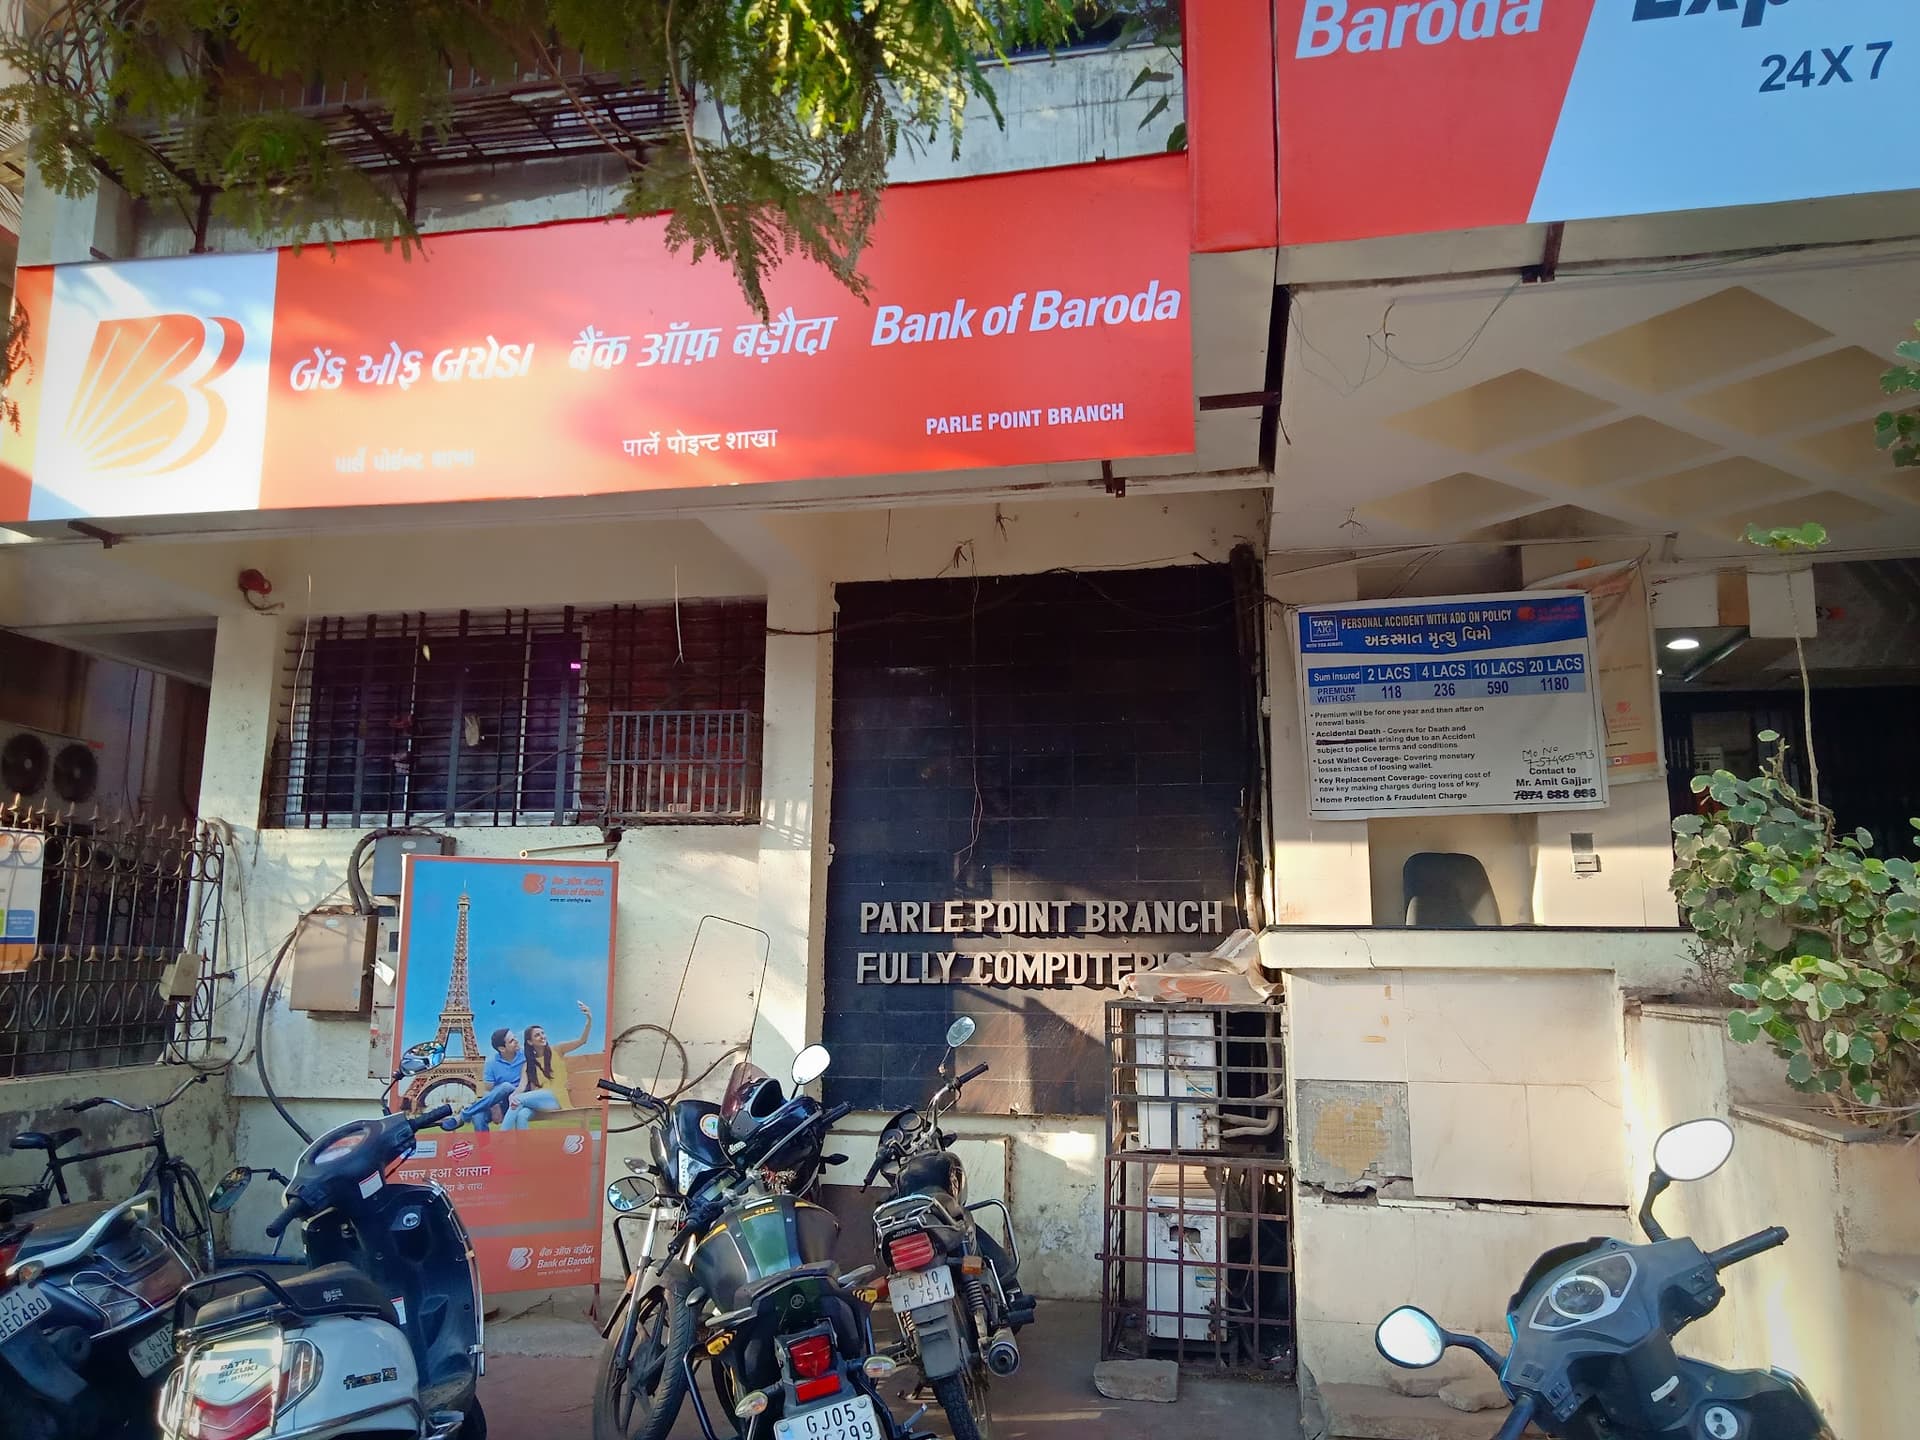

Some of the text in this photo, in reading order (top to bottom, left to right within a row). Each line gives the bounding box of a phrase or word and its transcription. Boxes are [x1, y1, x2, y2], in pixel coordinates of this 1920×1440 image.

[1296, 0, 1543, 59] Baroda
[871, 280, 1181, 346] Bank of Baroda
[568, 325, 631, 371] बैंक
[926, 403, 1124, 435] PARLE POINT BRANCH
[622, 431, 660, 457] पार्ले
[726, 429, 778, 449] शाखा
[1341, 609, 1512, 629] PERSONAL ACCIDENT WITH ADD ON POLICY
[1364, 633, 1422, 647] અકસ્માત
[1462, 625, 1491, 641] વિમો
[1422, 663, 1466, 678] 4 LACS
[1474, 661, 1525, 675] 10 LACS
[1529, 657, 1582, 673] 20 LACS
[1314, 672, 1360, 682] Sum Insured
[1367, 666, 1411, 680] 2 LACS
[1317, 686, 1355, 695] PREMIUM
[1434, 683, 1456, 697] 236
[1487, 681, 1509, 695] 590
[1541, 677, 1569, 691] 1180
[1317, 694, 1356, 703] WITH GST
[1382, 685, 1402, 699] 118
[1315, 711, 1348, 719] Premium
[1403, 708, 1419, 716] year
[1316, 729, 1356, 737] Accidental
[1387, 727, 1414, 735] Covers
[1317, 746, 1344, 754] subject
[1403, 753, 1437, 761] Covering
[1318, 765, 1342, 773] losses
[1529, 767, 1564, 775] Contact
[1319, 777, 1333, 785] Key
[1335, 776, 1386, 784] Replacement
[1516, 777, 1592, 786] Mr. Amit Gajjar
[1351, 784, 1378, 792] making
[1394, 793, 1436, 801] Fraudulent
[1438, 792, 1467, 800] Charge
[860, 900, 1223, 933] PARLE POINT BRANCH
[856, 952, 1168, 985] FULLY COMPUTER
[399, 1170, 426, 1180] सफर
[455, 1165, 491, 1177] आसान
[537, 1256, 595, 1269] Bank of Baroda
[908, 1271, 938, 1290] GJ10
[904, 1282, 950, 1308] R 7514
[0, 1292, 25, 1318] J21
[218, 1365, 258, 1379] SUZUKI
[806, 1403, 856, 1433] GJ05
